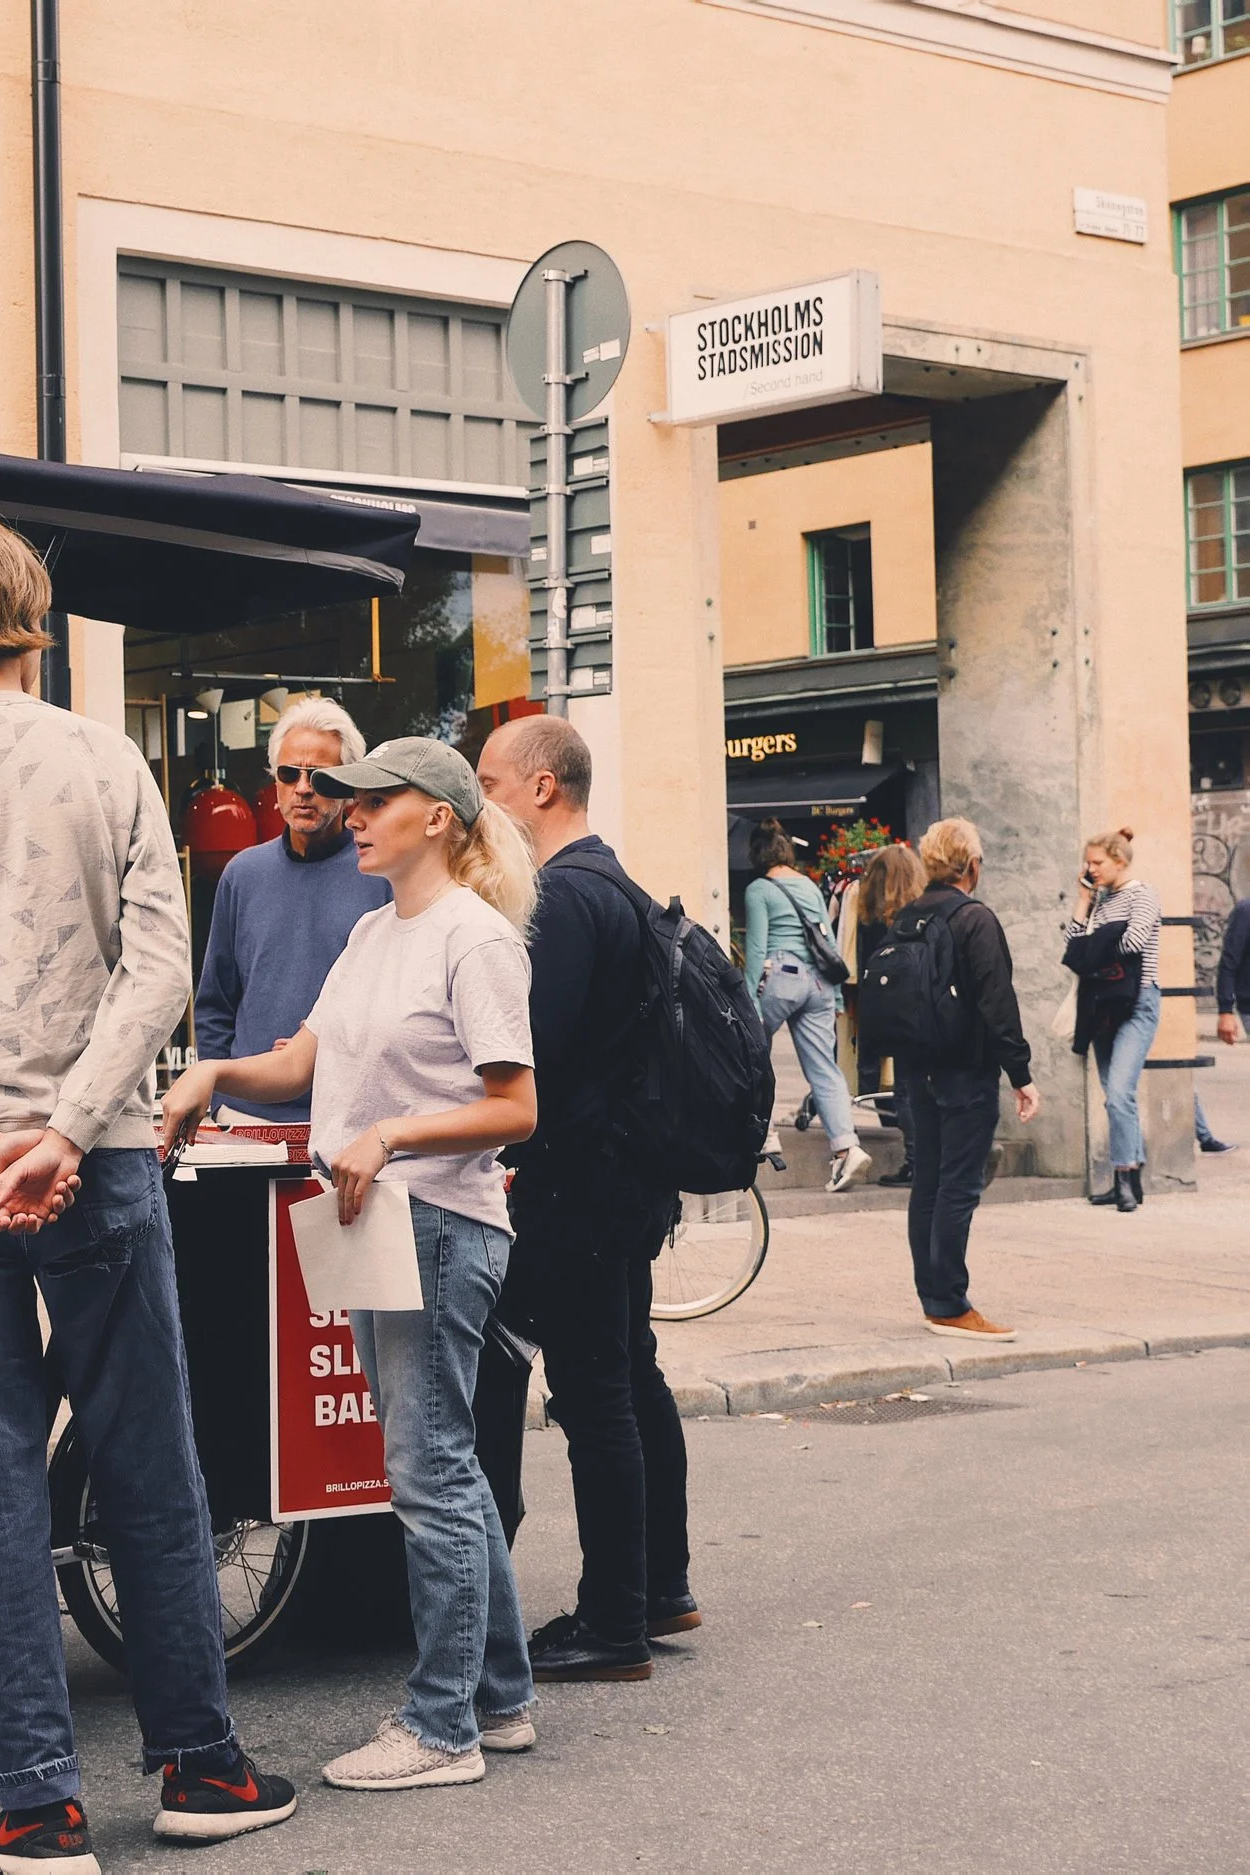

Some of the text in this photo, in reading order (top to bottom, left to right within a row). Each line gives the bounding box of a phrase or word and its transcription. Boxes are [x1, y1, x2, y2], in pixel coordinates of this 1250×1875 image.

[697, 296, 824, 352] STOCKHOLMS
[697, 330, 824, 381] STADSMISSION
[794, 370, 823, 387] hand
[725, 733, 797, 762] urgers
[309, 1343, 361, 1378] SLI
[325, 1479, 391, 1493] BRILLOPIZZA.S
